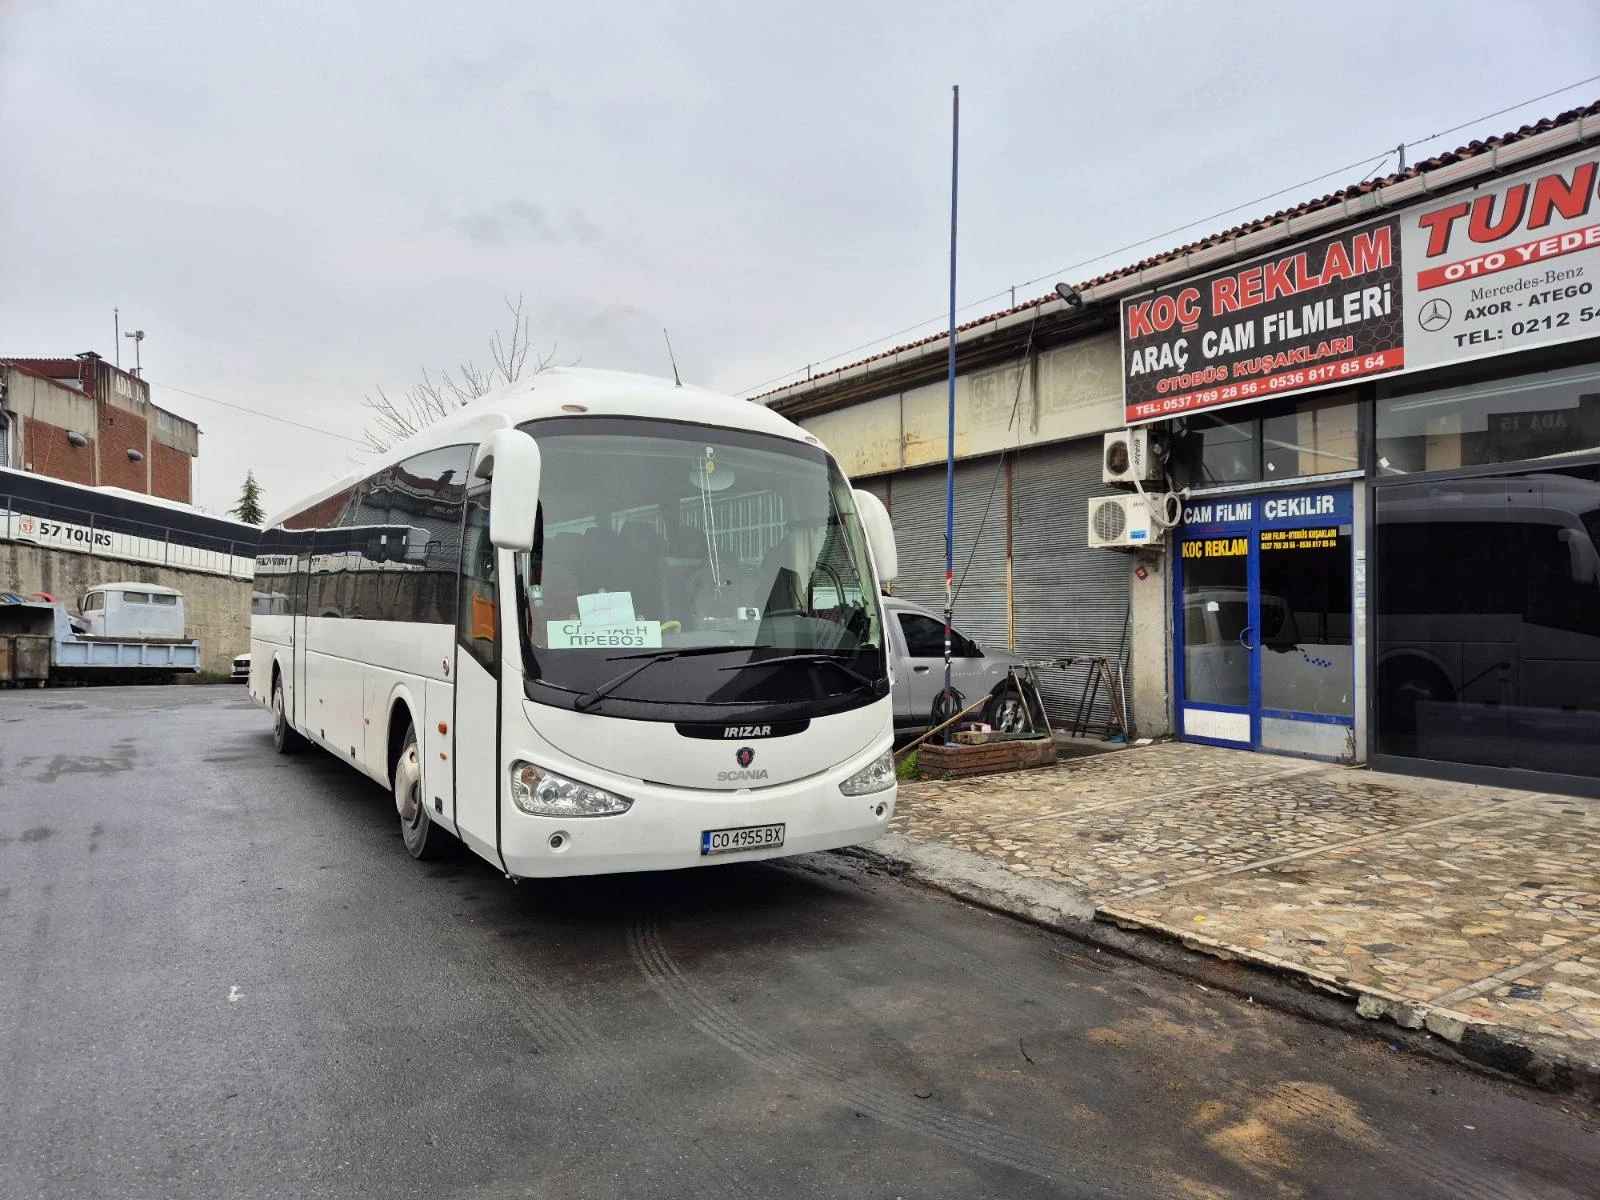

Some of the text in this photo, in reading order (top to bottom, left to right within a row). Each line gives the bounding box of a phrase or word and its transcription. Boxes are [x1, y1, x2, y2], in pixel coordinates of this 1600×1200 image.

[1418, 160, 1600, 258] TUN
[1444, 253, 1506, 280] OTO
[1128, 225, 1392, 339] KOÇ REKLAM
[1470, 266, 1584, 302] Mercedes-Benz
[1464, 300, 1512, 322] AXOR
[1528, 282, 1592, 307] ATEGO
[1454, 328, 1503, 347] TEL:
[1512, 312, 1570, 336] 0212
[1130, 338, 1188, 376] ARAÇ
[1202, 320, 1254, 359] CAM
[1157, 336, 1354, 393] OTOBÜS KUŞAKLARI
[116, 374, 132, 398] ADA
[1136, 404, 1161, 415] TEL:
[1164, 396, 1191, 410] 0537
[1196, 390, 1218, 404] 769
[1222, 386, 1237, 398] 28
[1241, 382, 1258, 394] 56
[1269, 372, 1304, 389] 0536
[1308, 365, 1336, 381] 817
[1340, 360, 1360, 374] 85
[1364, 354, 1385, 368] 64
[1184, 506, 1212, 524] CAM
[40, 523, 111, 546] 57 TOURS
[1182, 538, 1248, 558] KOÇ REKLAM
[570, 636, 644, 646] ПРЕВОЗ
[724, 725, 772, 738] IRIZAR
[717, 770, 768, 781] SCANIA
[712, 834, 730, 848] CO
[732, 830, 762, 846] 4955
[765, 828, 781, 842] BX
